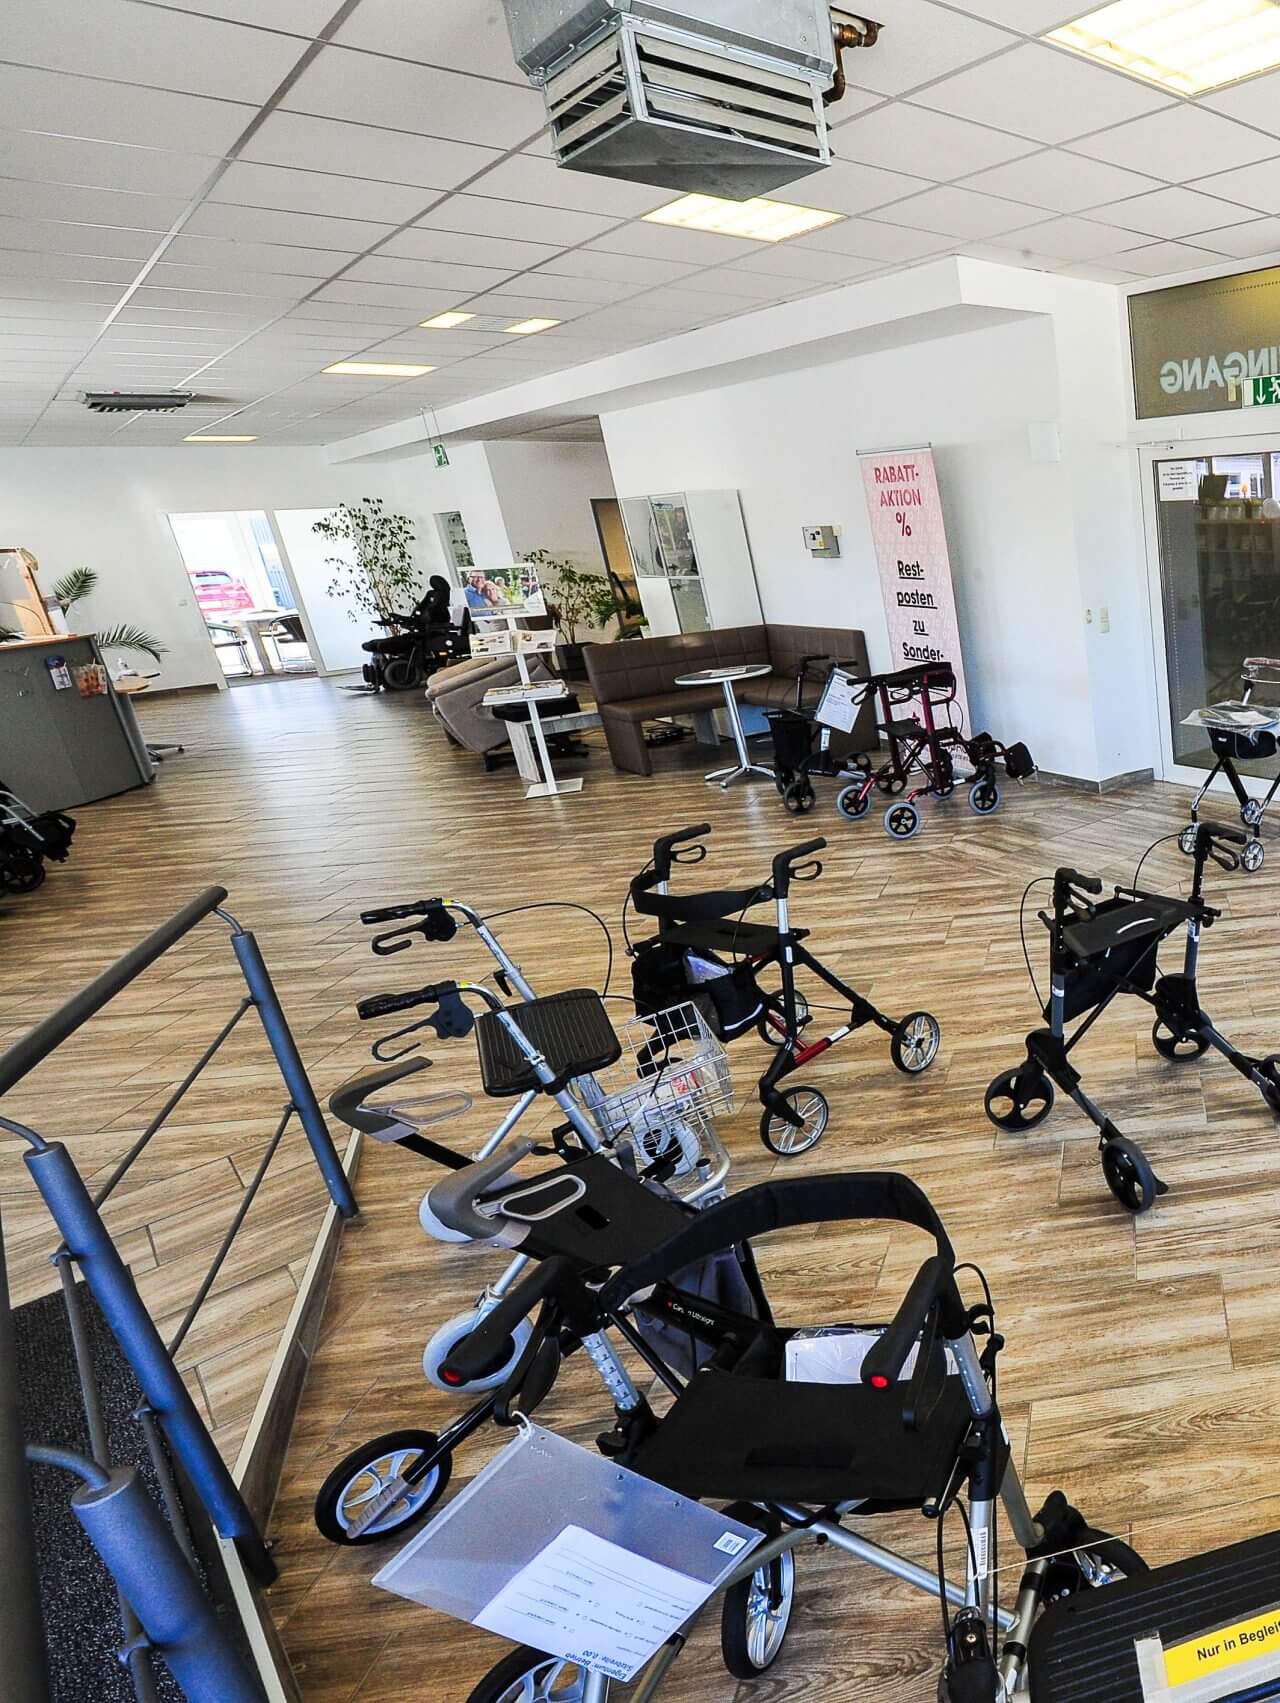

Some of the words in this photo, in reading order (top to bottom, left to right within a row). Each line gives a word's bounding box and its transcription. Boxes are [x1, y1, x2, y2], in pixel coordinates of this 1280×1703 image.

[874, 464, 919, 483] RABATT-
[880, 489, 921, 507] AKTION
[896, 512, 912, 536] %
[897, 560, 924, 576] Rest-
[897, 589, 934, 606] posten
[912, 620, 925, 632] zu
[902, 642, 944, 660] Sonder-
[565, 1652, 591, 1665] Betrieb
[1197, 1644, 1221, 1661] Nur
[1223, 1640, 1236, 1651] in
[592, 1664, 627, 1680] Eigentum:
[599, 1656, 634, 1671] Sitzbreite:
